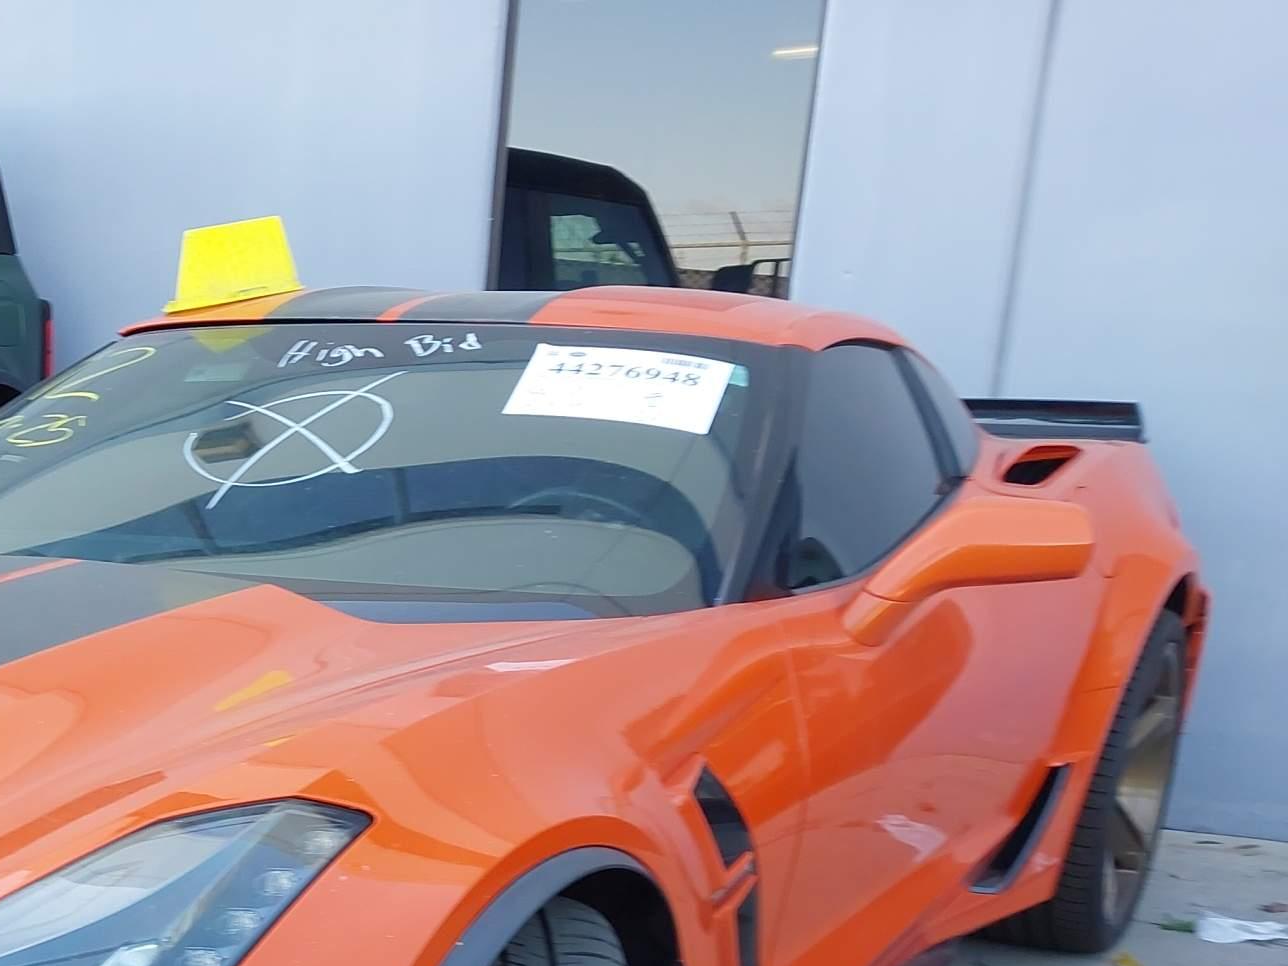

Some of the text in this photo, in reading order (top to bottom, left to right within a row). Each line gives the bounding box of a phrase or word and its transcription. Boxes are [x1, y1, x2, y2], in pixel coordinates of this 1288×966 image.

[276, 332, 483, 368] High Bid
[547, 361, 701, 387] 44276948
